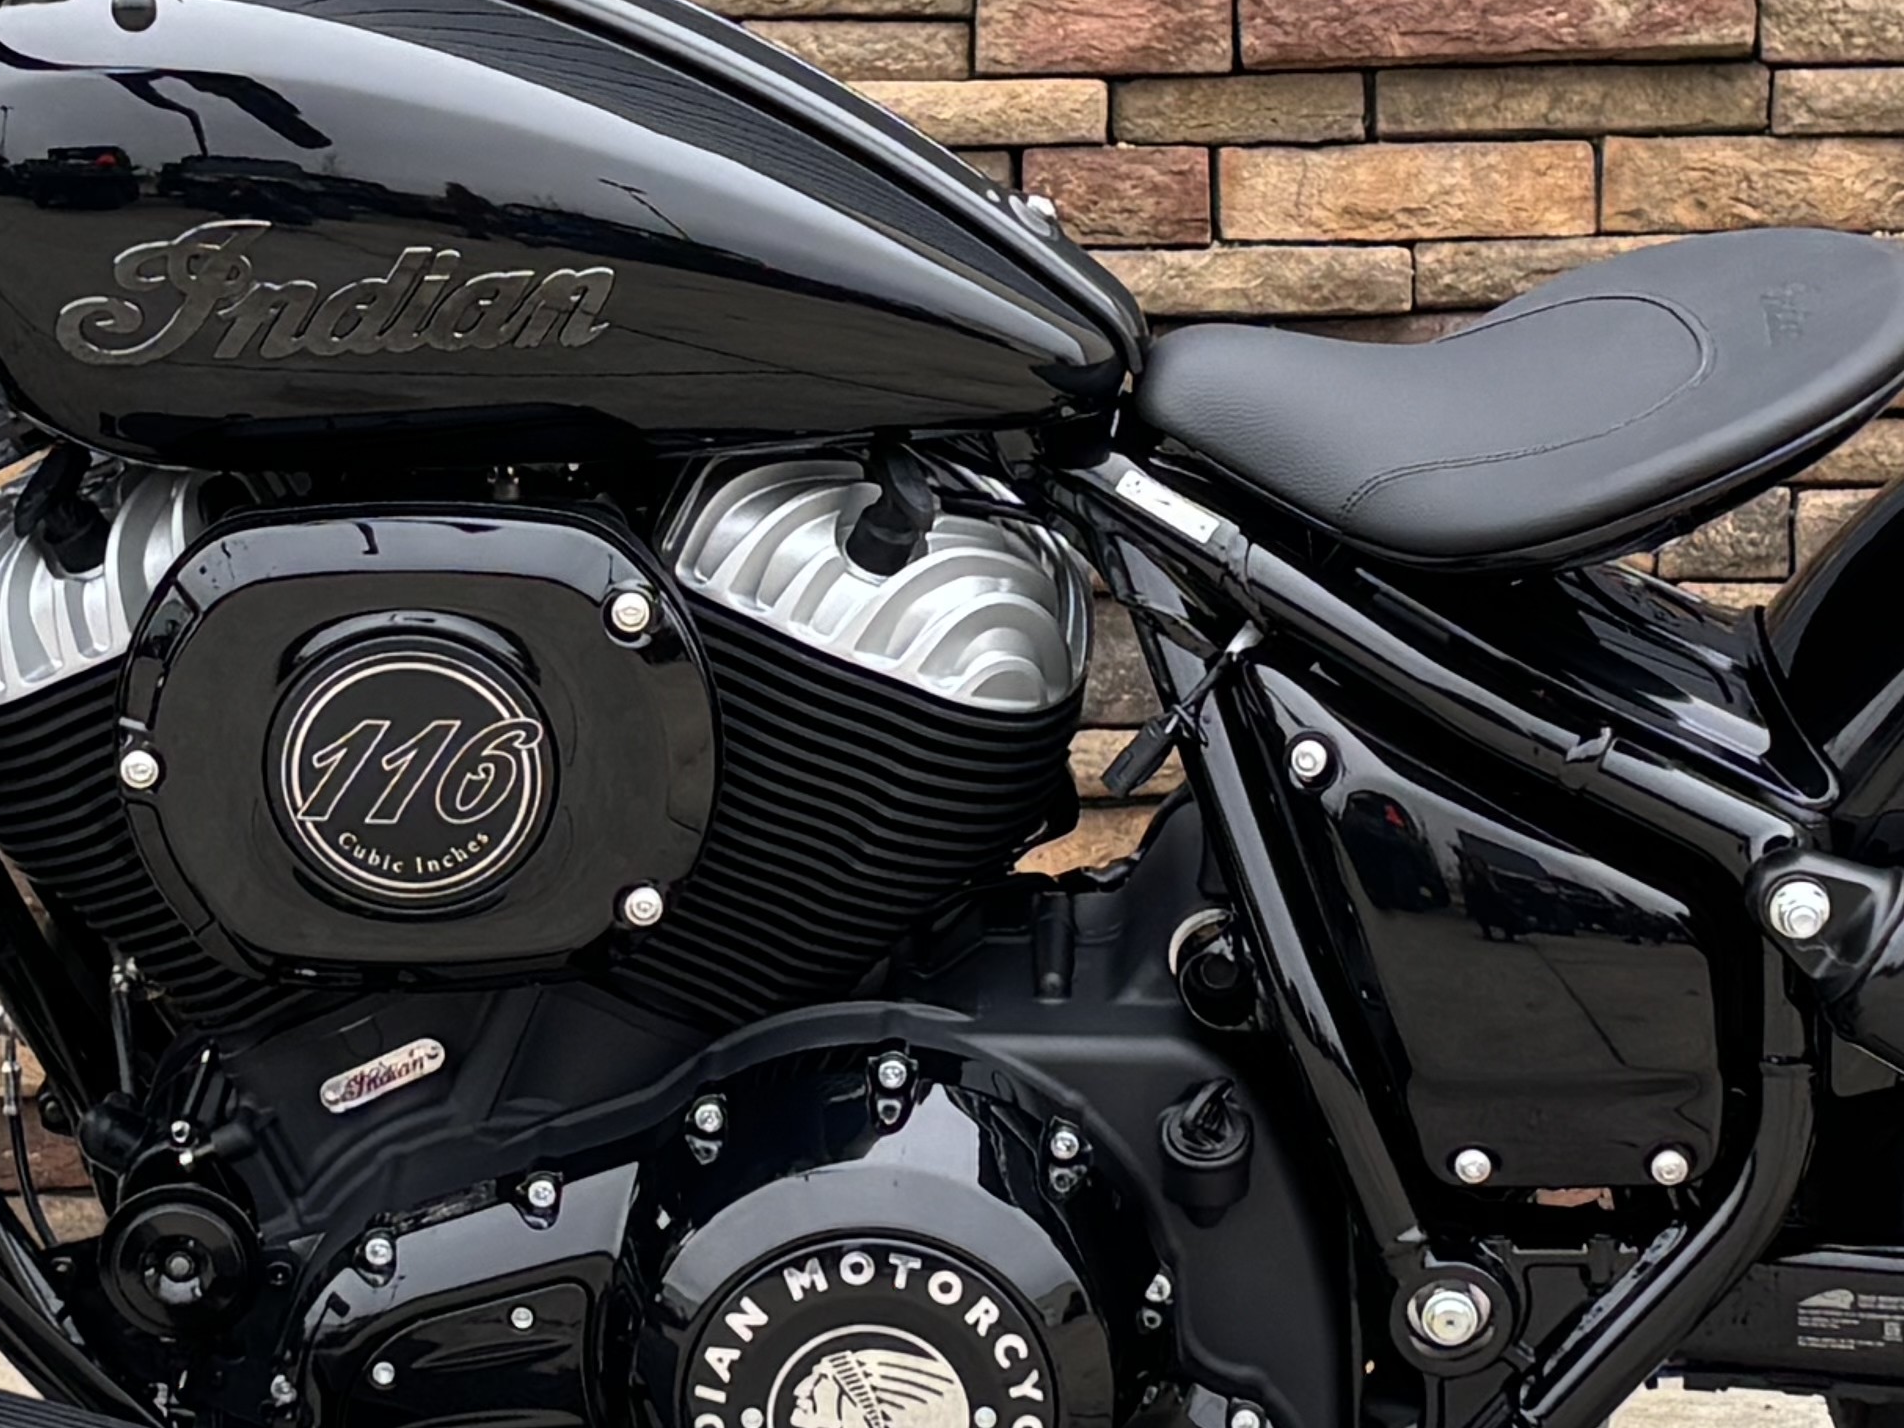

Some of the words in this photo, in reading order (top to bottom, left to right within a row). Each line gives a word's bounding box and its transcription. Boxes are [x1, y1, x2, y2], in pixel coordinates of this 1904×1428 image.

[55, 219, 615, 365] Indian
[297, 718, 543, 823] 116
[338, 832, 403, 873] Cubic
[416, 832, 490, 874] Inches
[340, 1048, 428, 1103] Indian
